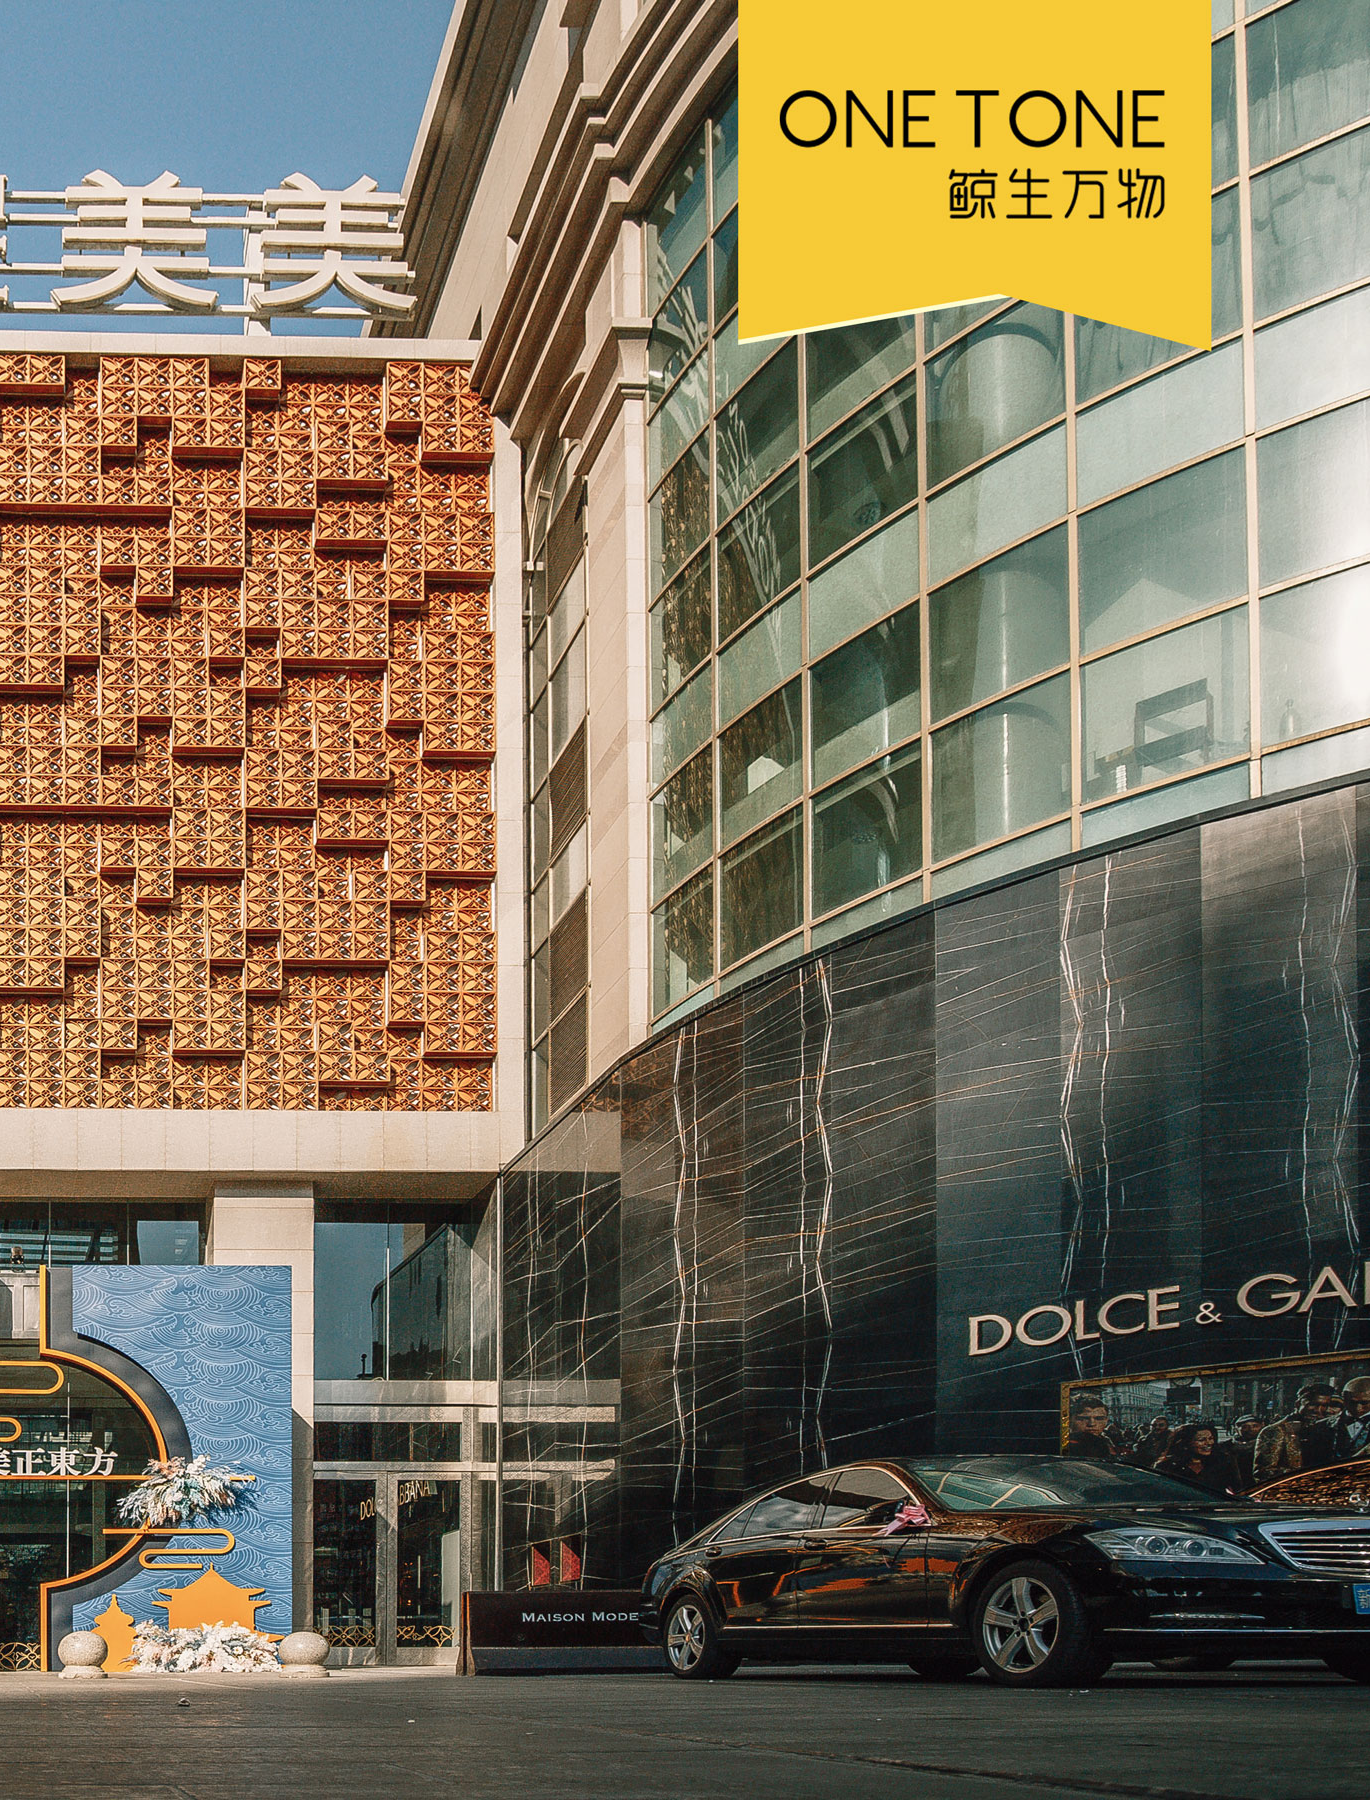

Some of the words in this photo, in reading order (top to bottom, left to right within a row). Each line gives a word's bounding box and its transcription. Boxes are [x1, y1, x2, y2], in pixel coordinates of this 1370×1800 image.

[50, 168, 418, 312] 美美
[968, 1285, 1180, 1356] DOLCE
[1195, 1302, 1223, 1325] &
[1236, 1260, 1370, 1318] GA
[522, 1612, 585, 1623] MAISON
[592, 1611, 639, 1622] MODE
